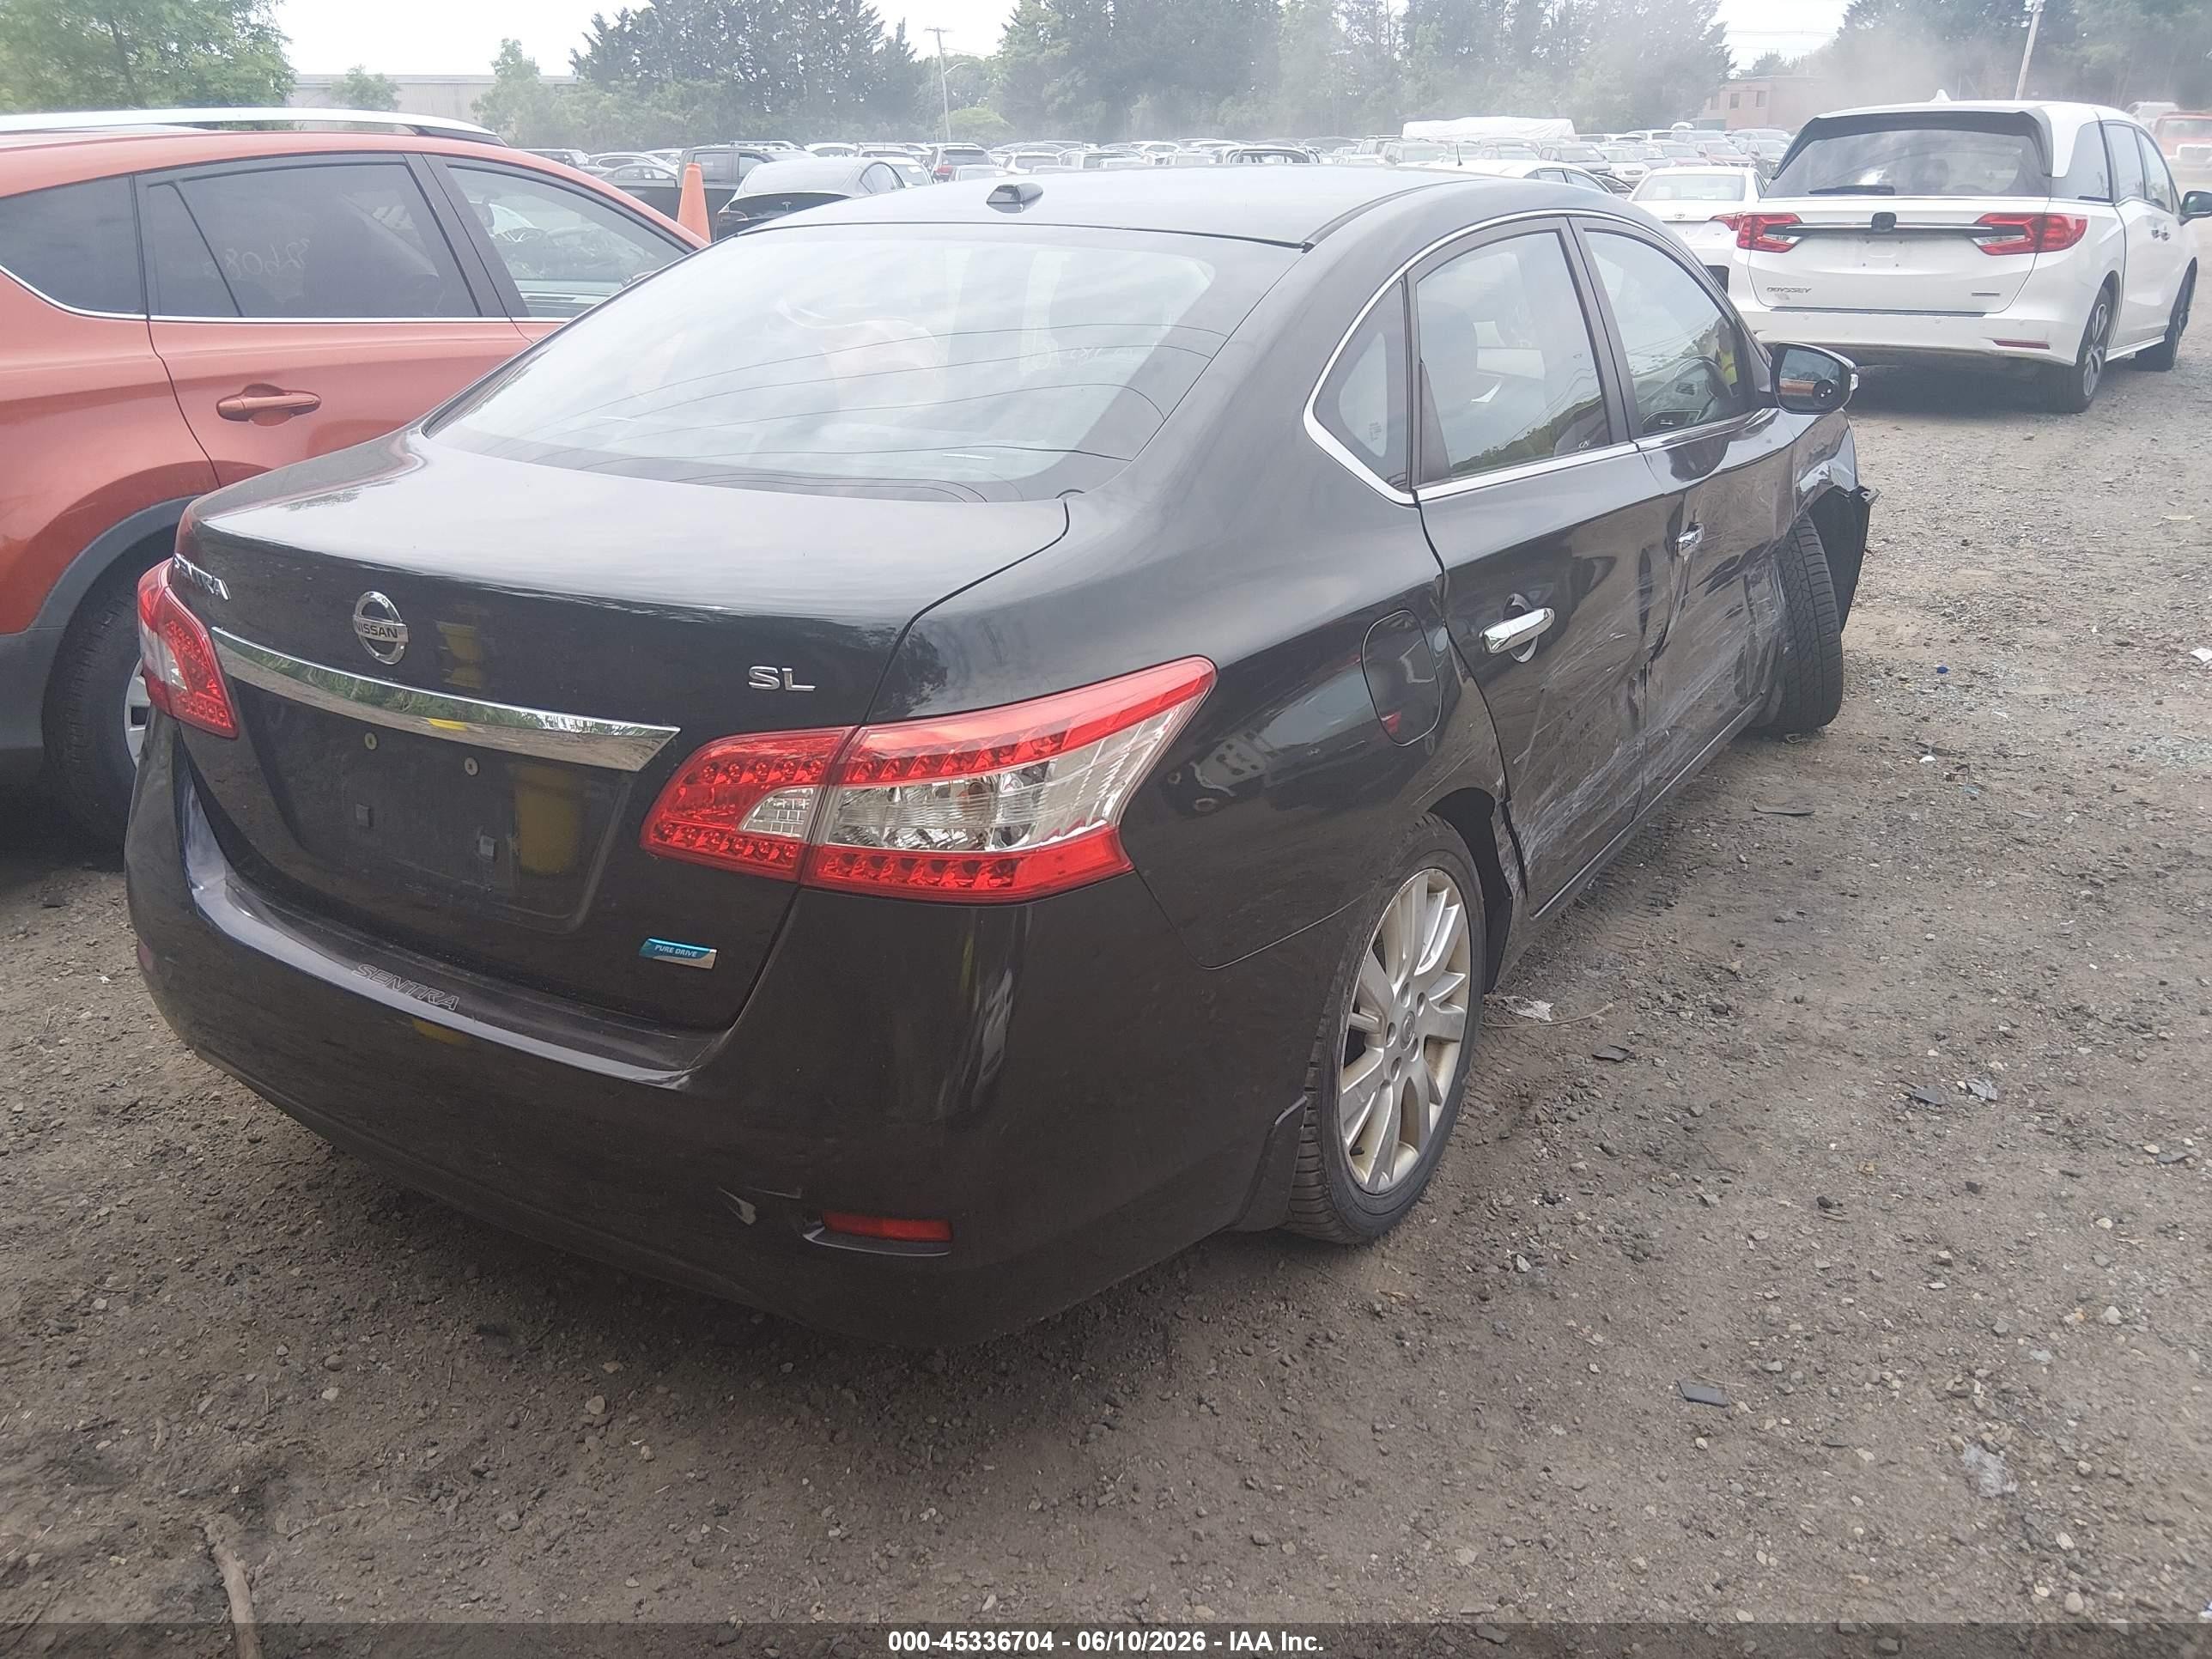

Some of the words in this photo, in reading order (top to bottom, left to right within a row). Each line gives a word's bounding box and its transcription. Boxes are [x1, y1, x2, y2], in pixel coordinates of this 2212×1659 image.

[357, 623, 398, 639] NISSAN
[748, 665, 817, 692] SL
[654, 945, 675, 953] PURE
[675, 948, 699, 957] DRIVE
[350, 963, 460, 1011] SENTRA
